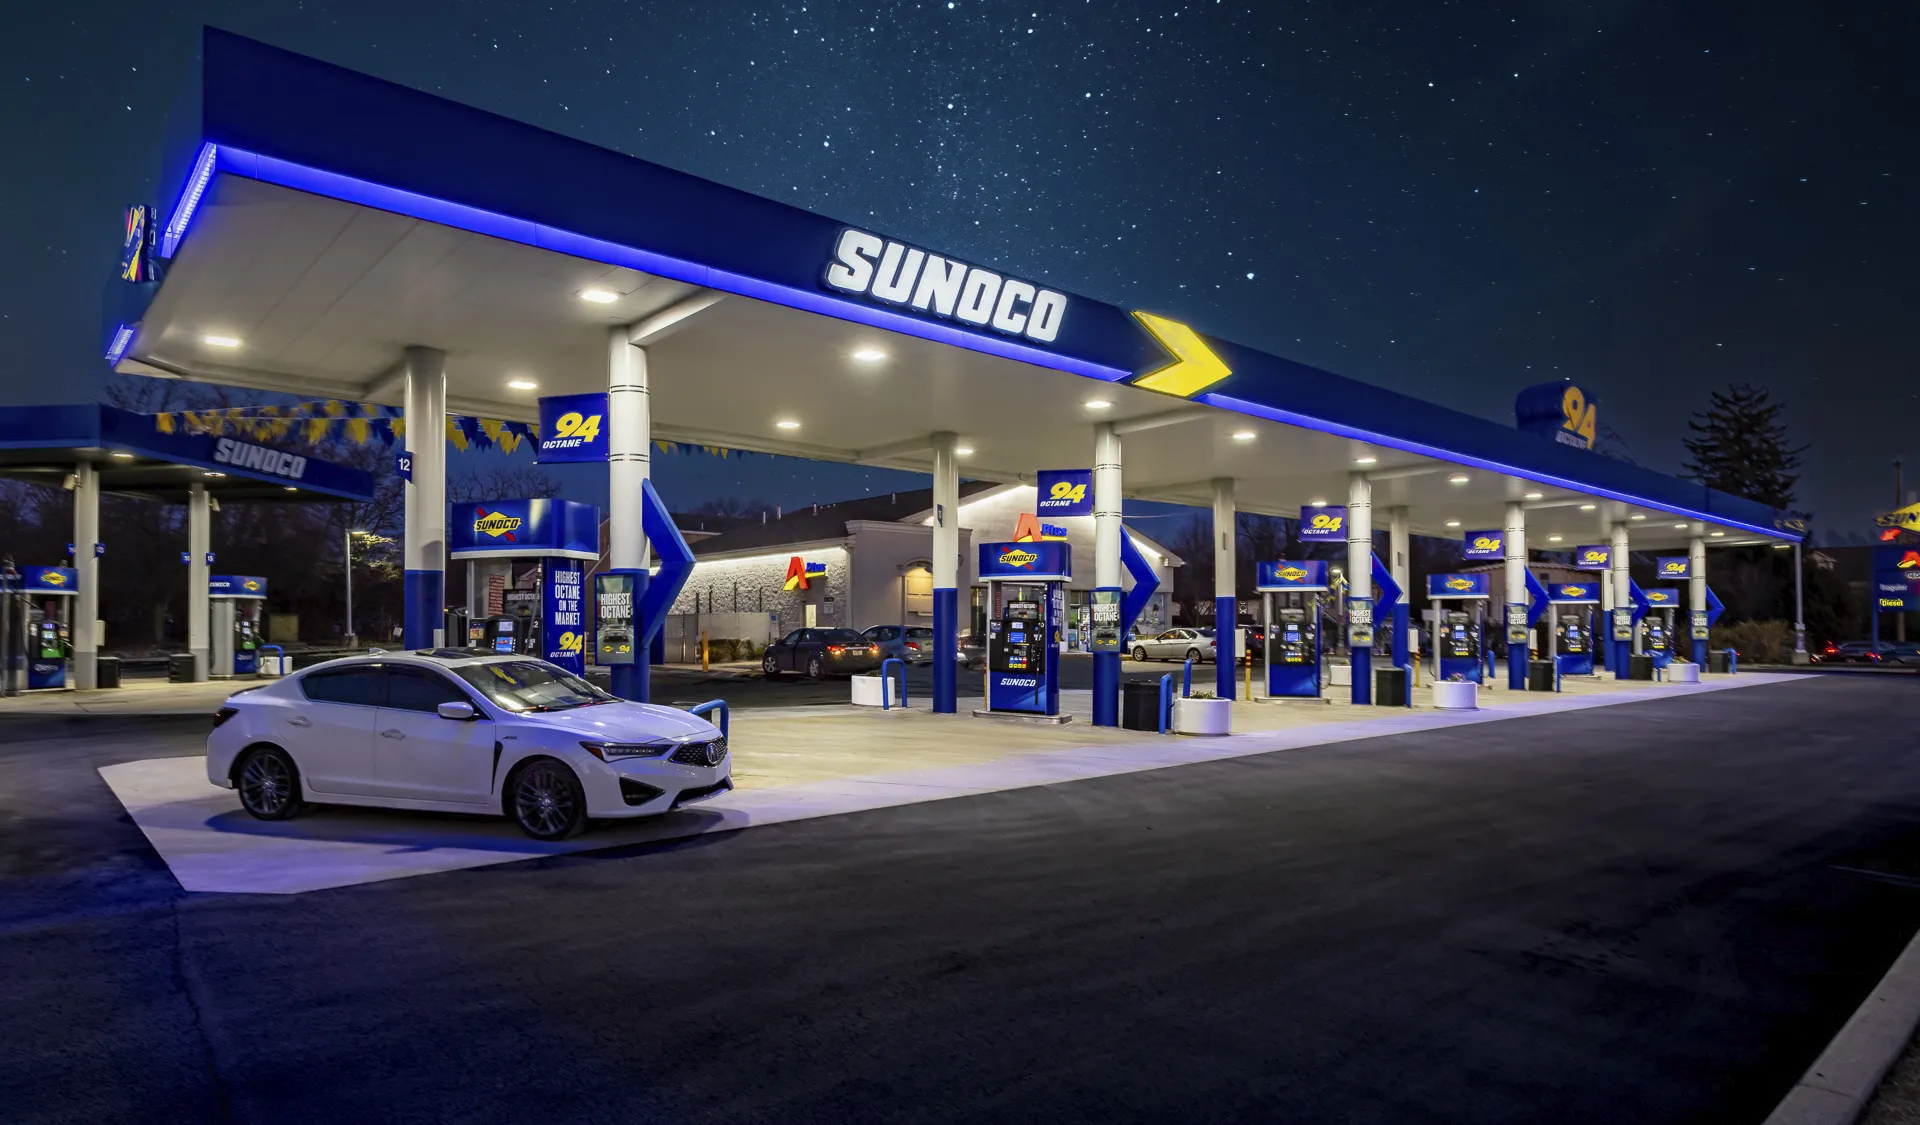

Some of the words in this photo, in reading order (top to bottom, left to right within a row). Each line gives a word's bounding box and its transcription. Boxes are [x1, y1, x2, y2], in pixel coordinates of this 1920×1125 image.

[828, 229, 1068, 343] SUNOCO
[1562, 386, 1596, 450] 94
[554, 412, 602, 442] 94
[542, 439, 582, 449] OCTANE
[214, 437, 307, 479] SUNOCO
[398, 458, 410, 471] 12
[1050, 482, 1087, 503] 94
[476, 519, 519, 530] SUNOCO
[1311, 514, 1342, 532] 94
[1041, 524, 1068, 536] Plus
[1474, 537, 1501, 552] 94
[1000, 554, 1035, 562] SUNOCO
[1584, 551, 1608, 564] 94
[1666, 562, 1687, 574] 94
[555, 571, 580, 584] HIGHEST
[555, 585, 580, 599] OCTANE
[559, 600, 567, 611] ON
[568, 600, 578, 611] THE
[601, 593, 630, 605] HIGHEST
[601, 605, 631, 618] OCTANE
[1094, 612, 1118, 621] OCTANE
[555, 612, 580, 625] MARKET
[559, 632, 583, 654] 94
[1000, 678, 1036, 687] SUNOCO
